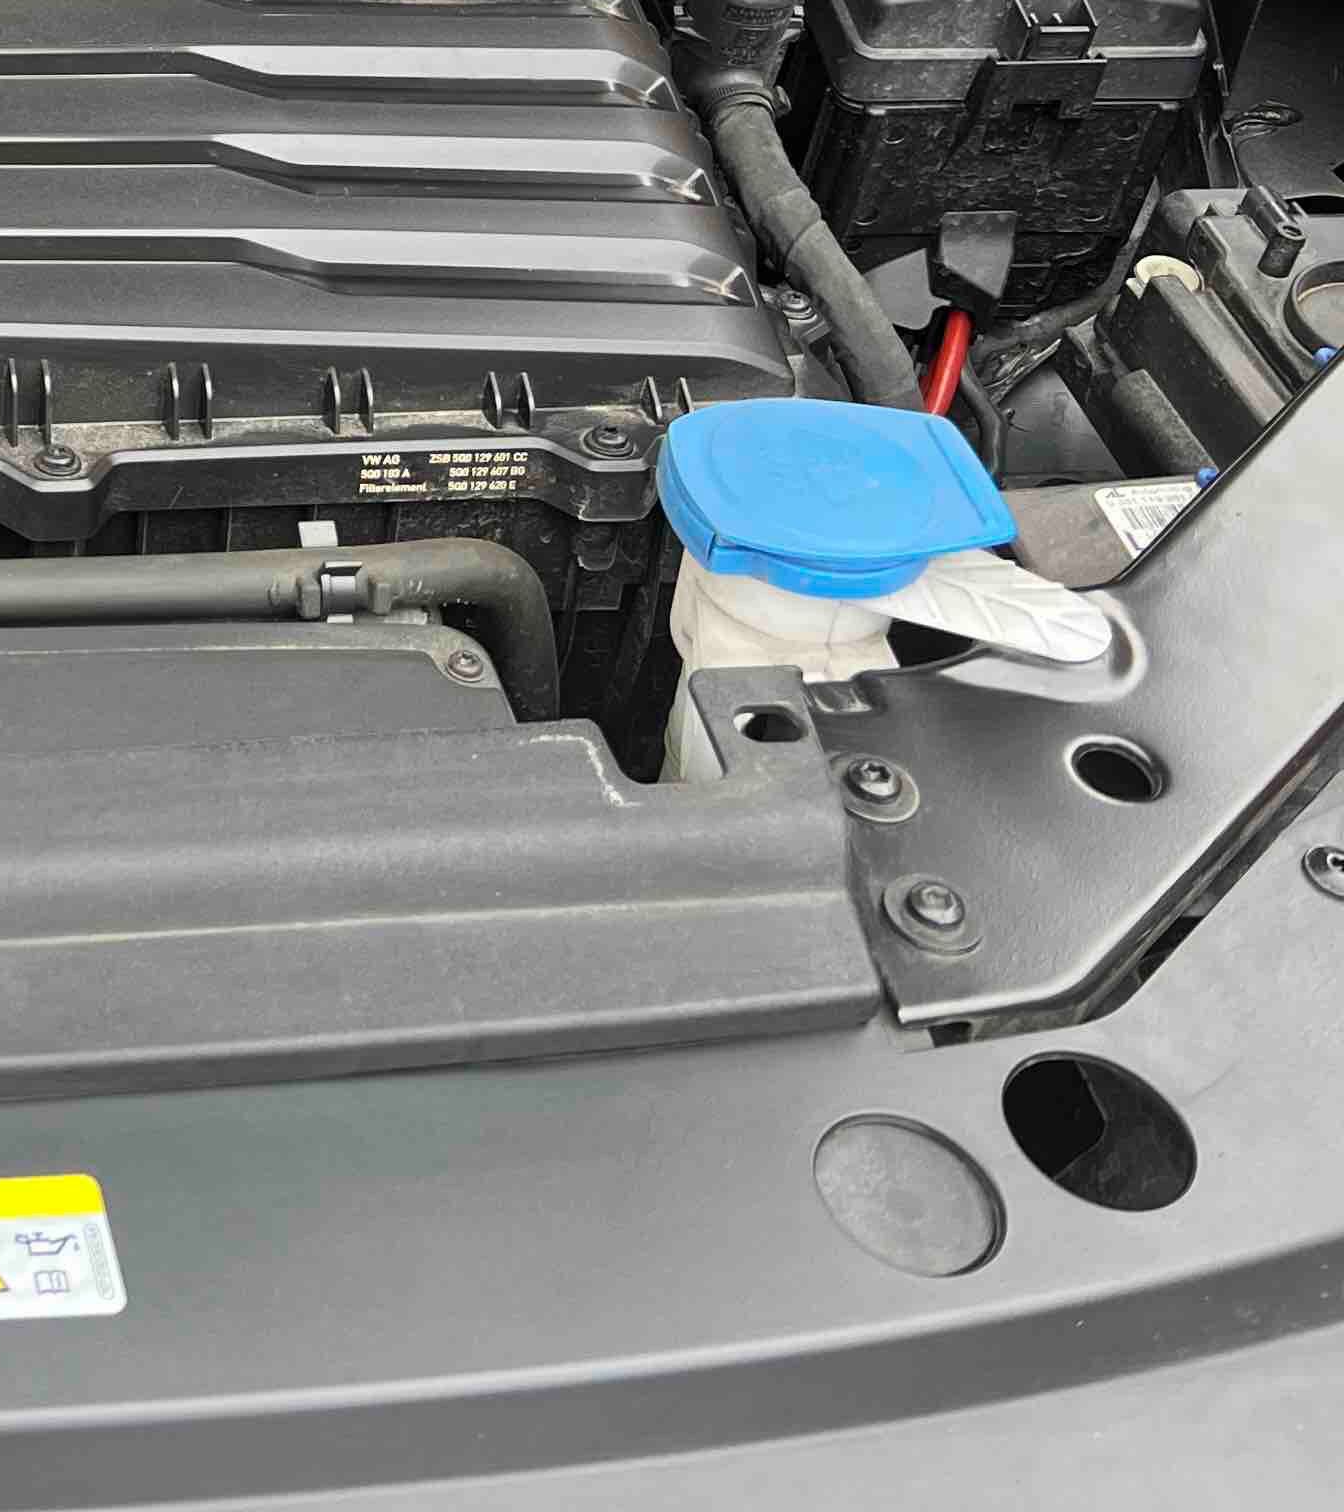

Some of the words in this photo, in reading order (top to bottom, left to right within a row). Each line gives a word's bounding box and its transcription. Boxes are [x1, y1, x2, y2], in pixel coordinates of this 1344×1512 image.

[362, 454, 380, 465] VW
[475, 453, 492, 463] 129
[513, 452, 528, 462] CC
[471, 466, 488, 477] 129
[470, 480, 487, 491] 129
